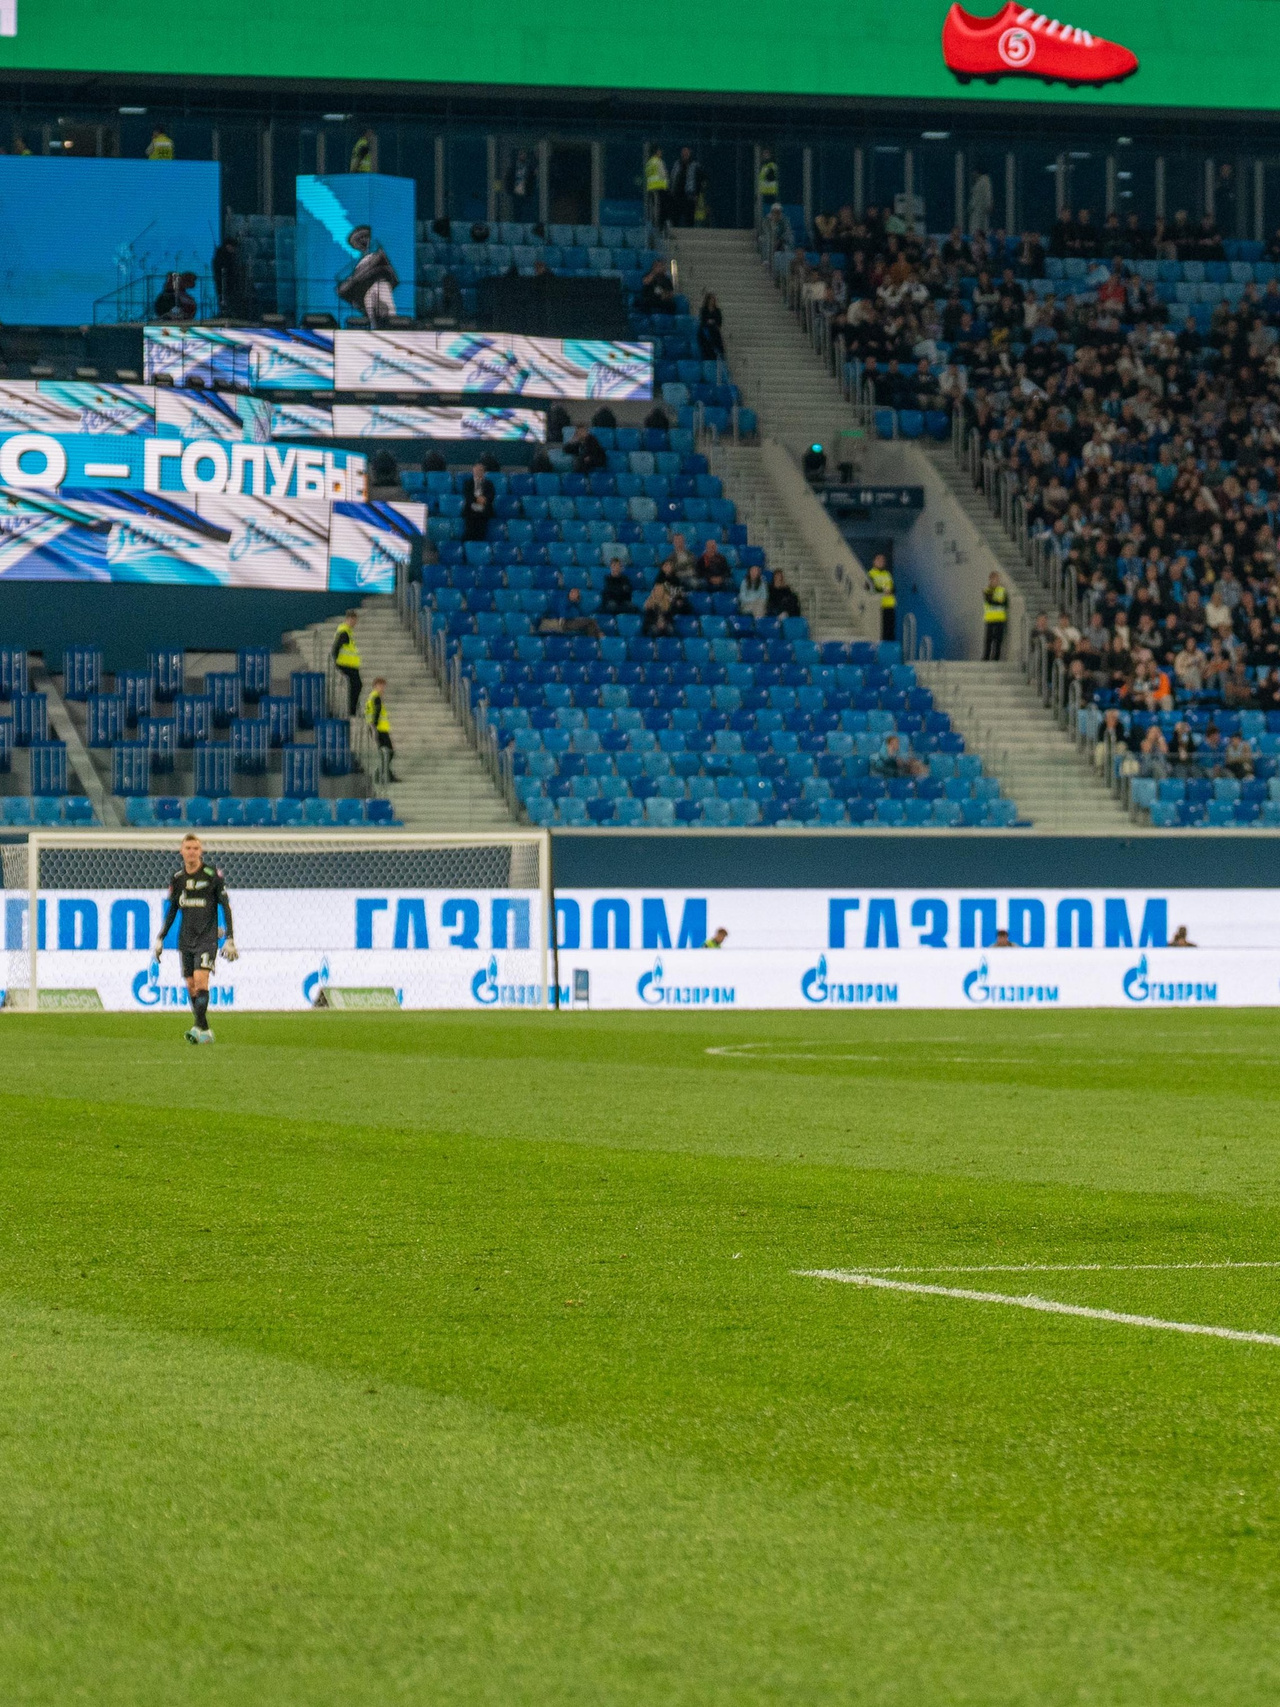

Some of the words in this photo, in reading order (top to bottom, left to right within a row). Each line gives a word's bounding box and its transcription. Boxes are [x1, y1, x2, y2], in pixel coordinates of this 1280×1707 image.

[1008, 33, 1026, 60] 5
[355, 897, 708, 949] ГАЗПРОМ
[828, 897, 1168, 948] ГАЗПРОМ
[161, 986, 234, 1006] ГАЗОМ
[665, 987, 735, 1004] ГАЗПРОМ
[829, 984, 898, 1003] ГАЗПРОМ
[991, 986, 1059, 1002] ГАЗПРОМ
